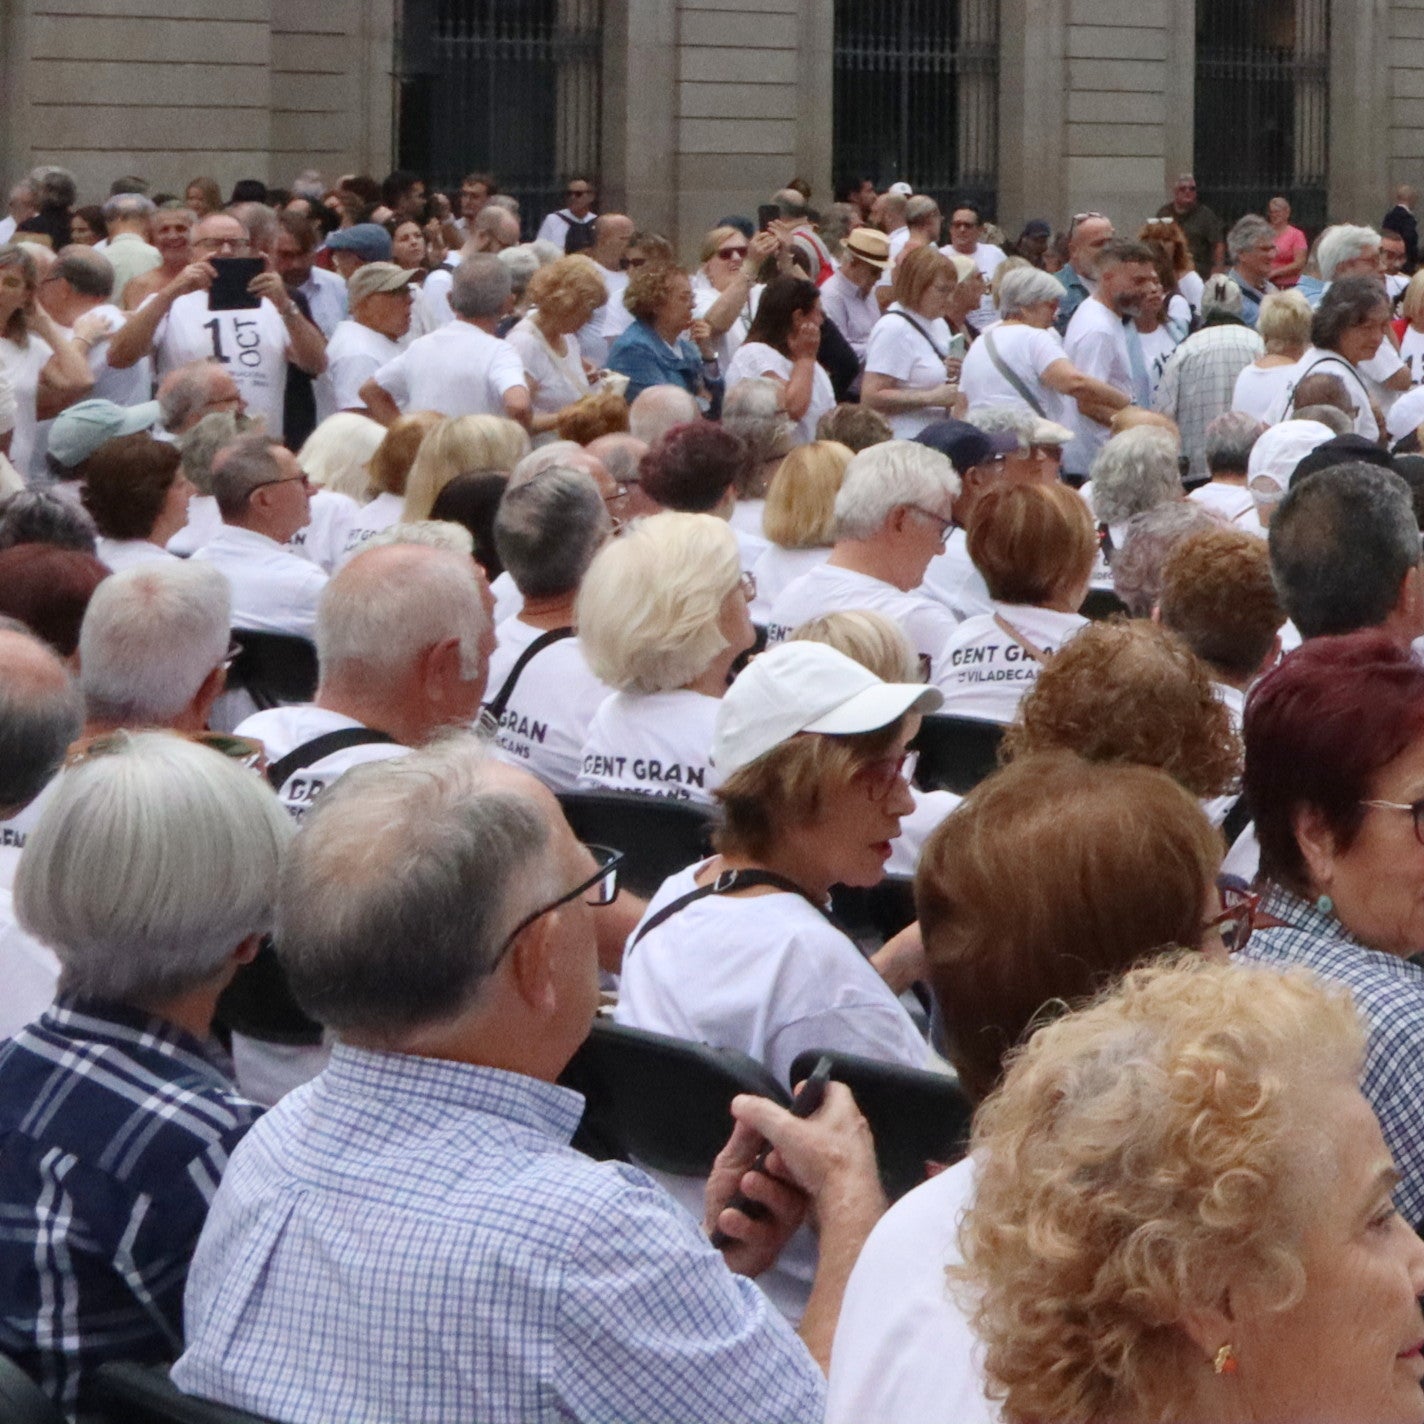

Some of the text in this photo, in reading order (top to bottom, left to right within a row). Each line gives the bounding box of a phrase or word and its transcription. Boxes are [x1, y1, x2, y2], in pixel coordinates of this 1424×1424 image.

[203, 317, 261, 367] 1 OCT
[952, 644, 999, 667] GENT
[967, 669, 1035, 683] VILADECA
[583, 754, 705, 788] GENT GRAN
